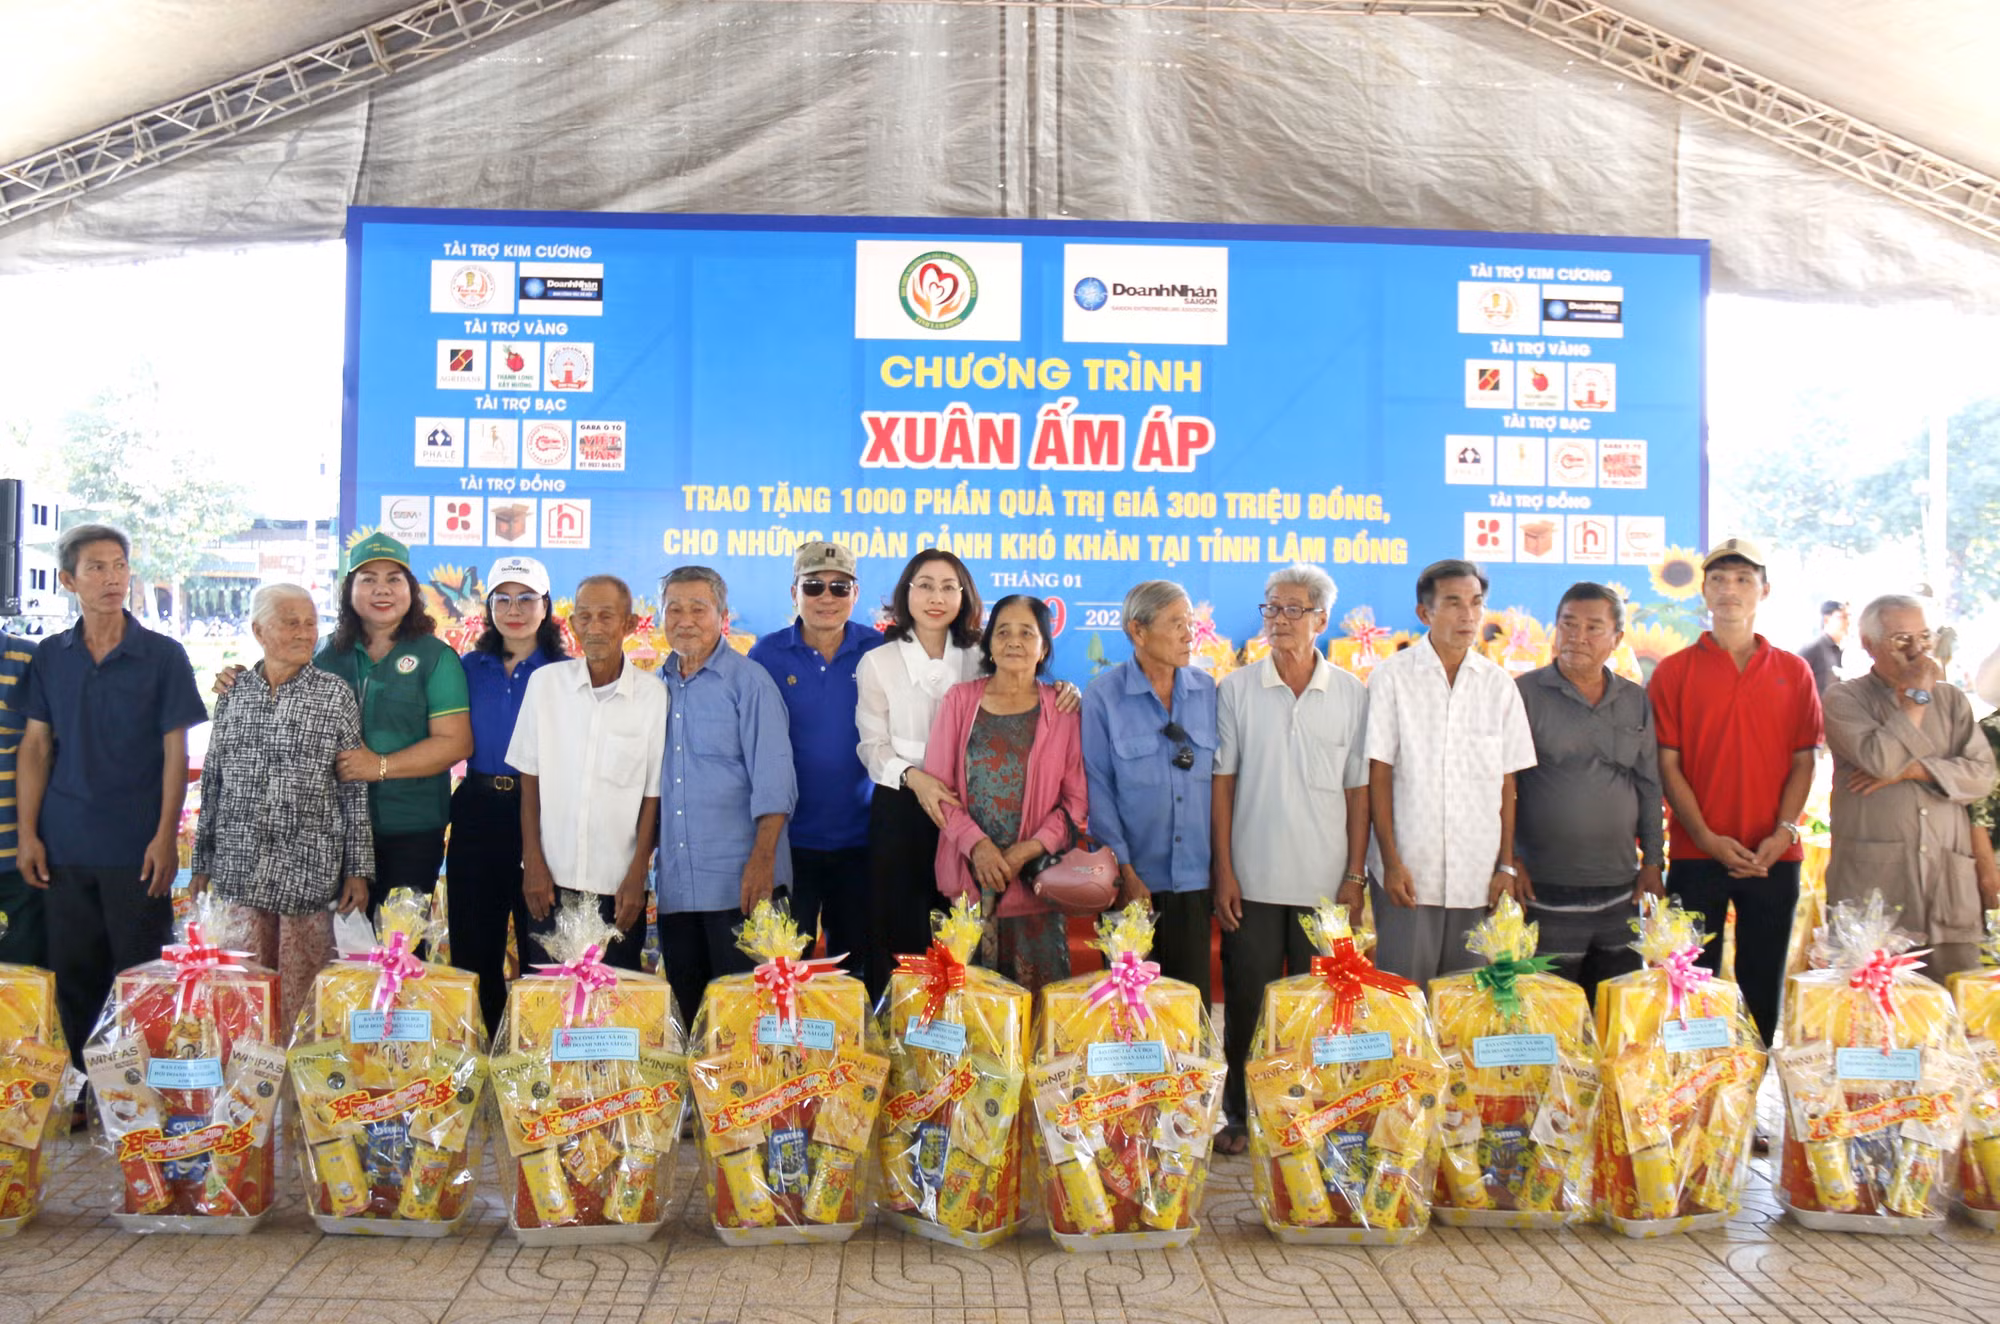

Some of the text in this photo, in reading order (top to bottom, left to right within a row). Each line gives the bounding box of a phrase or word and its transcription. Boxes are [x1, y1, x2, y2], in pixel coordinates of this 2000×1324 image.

[443, 240, 593, 260] TÀI TRỢ KIM CƯƠNG
[1470, 262, 1612, 282] TÀI TRỢ KIM CƯƠNG
[464, 318, 568, 338] TÀI TRỢ VÀNG
[1491, 340, 1591, 358] TÀI TRỢ VÀNG
[881, 350, 1202, 392] CHƯƠNG TRÌNH
[475, 394, 567, 414] TÀI TRỢ BẠC
[1503, 413, 1591, 432] TÀI TRỢ BẠC
[864, 398, 1212, 469] XUÂN ẤM ÁP
[459, 473, 566, 494] TÀI TRỢ ĐỒNG
[682, 480, 1391, 525] TRAO TẶNG 1000 PHẦN QUÀ TRỊ GIÁ 300 TRIỆU ĐỒNG,
[1489, 491, 1512, 507] TÀI
[1515, 494, 1544, 511] TRỢ
[664, 529, 719, 556] CHO
[832, 526, 908, 558] HOÀN
[916, 524, 993, 559] CẢNH
[1000, 528, 1056, 560] KHÓ
[1064, 530, 1139, 561] KHĂN
[1148, 535, 1190, 567] TẠI
[1198, 528, 1260, 563] TỈNH
[1267, 532, 1326, 564] LÂM
[1333, 529, 1408, 564] ĐỒNG
[990, 570, 1082, 588] THÁNG 01
[1085, 609, 1121, 626] 202
[773, 1131, 805, 1143] OREO
